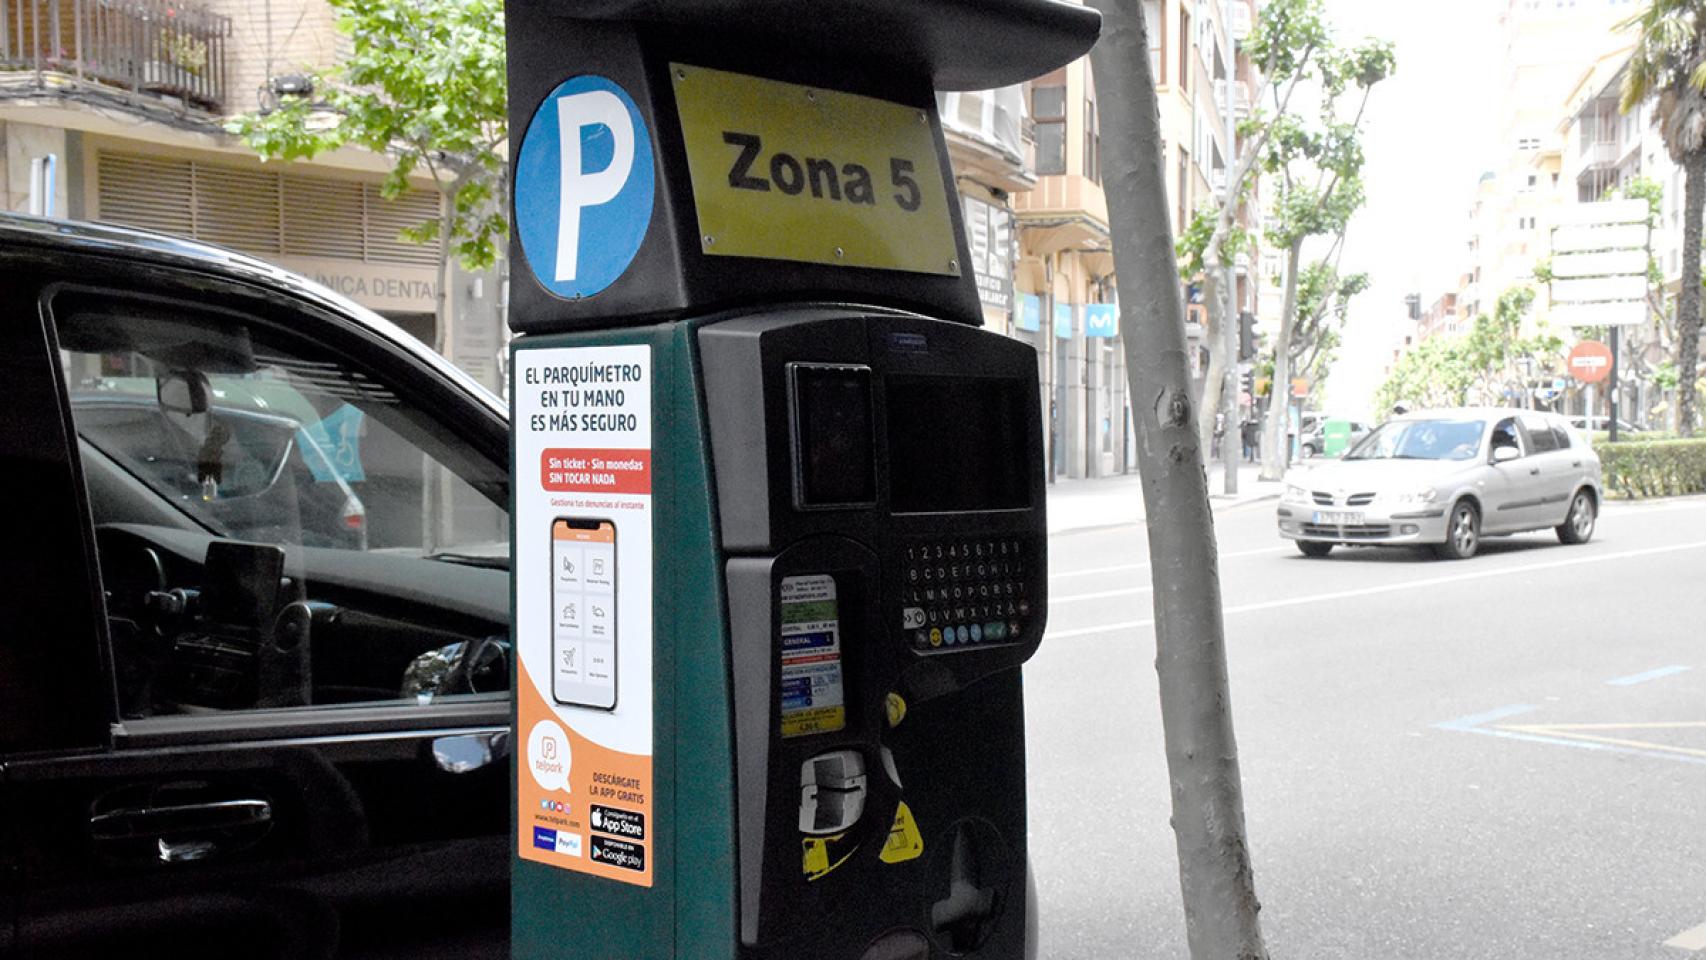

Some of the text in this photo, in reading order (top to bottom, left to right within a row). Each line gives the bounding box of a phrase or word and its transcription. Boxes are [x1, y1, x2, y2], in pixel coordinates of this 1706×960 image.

[723, 131, 922, 213] Zona 5
[555, 90, 635, 282] P
[525, 362, 642, 387] EL PARQUÍMETRO
[541, 389, 625, 407] EN TU MANO
[531, 411, 637, 432] ES MÁS SEGURO
[549, 457, 643, 470] Sin ticket Sin monedas
[549, 472, 616, 485] SIN TOCAR NADA
[535, 760, 563, 774] telpark
[592, 772, 640, 789] DESCÁRGATE
[590, 784, 644, 804] LA APP GRATIS
[603, 817, 642, 835] App Store
[602, 848, 642, 868] Google play
